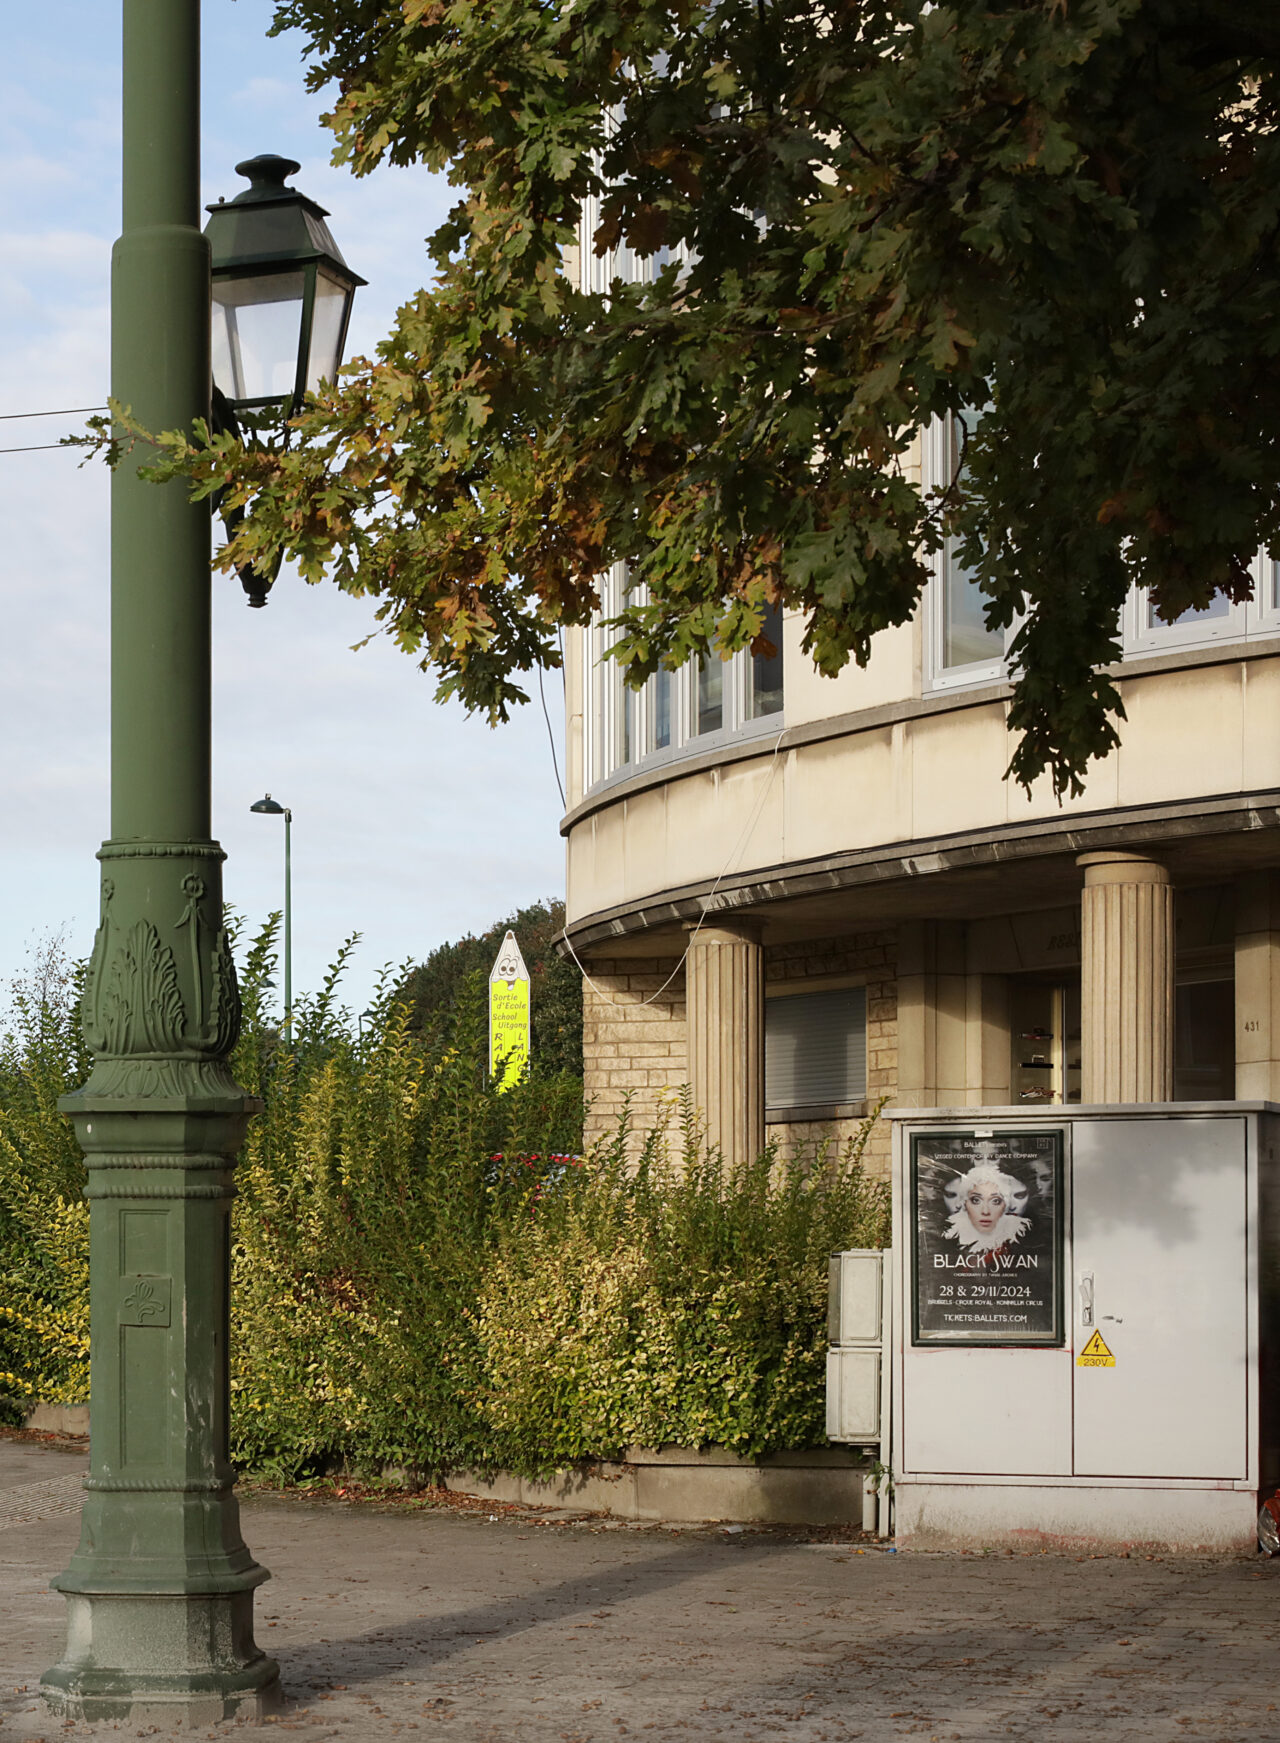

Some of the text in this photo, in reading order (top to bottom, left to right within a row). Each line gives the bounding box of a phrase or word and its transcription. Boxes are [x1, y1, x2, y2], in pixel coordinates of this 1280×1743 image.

[492, 993, 518, 1001] Sortie
[497, 1002, 527, 1010] d'Ecole
[492, 1012, 517, 1020] School
[498, 1021, 527, 1030] Uitgang
[1244, 1020, 1259, 1033] 431
[933, 1251, 1039, 1273] BLACK SWAN
[939, 1285, 1032, 1297] 28 & 29/11/2024
[1083, 1358, 1108, 1367] 230V
